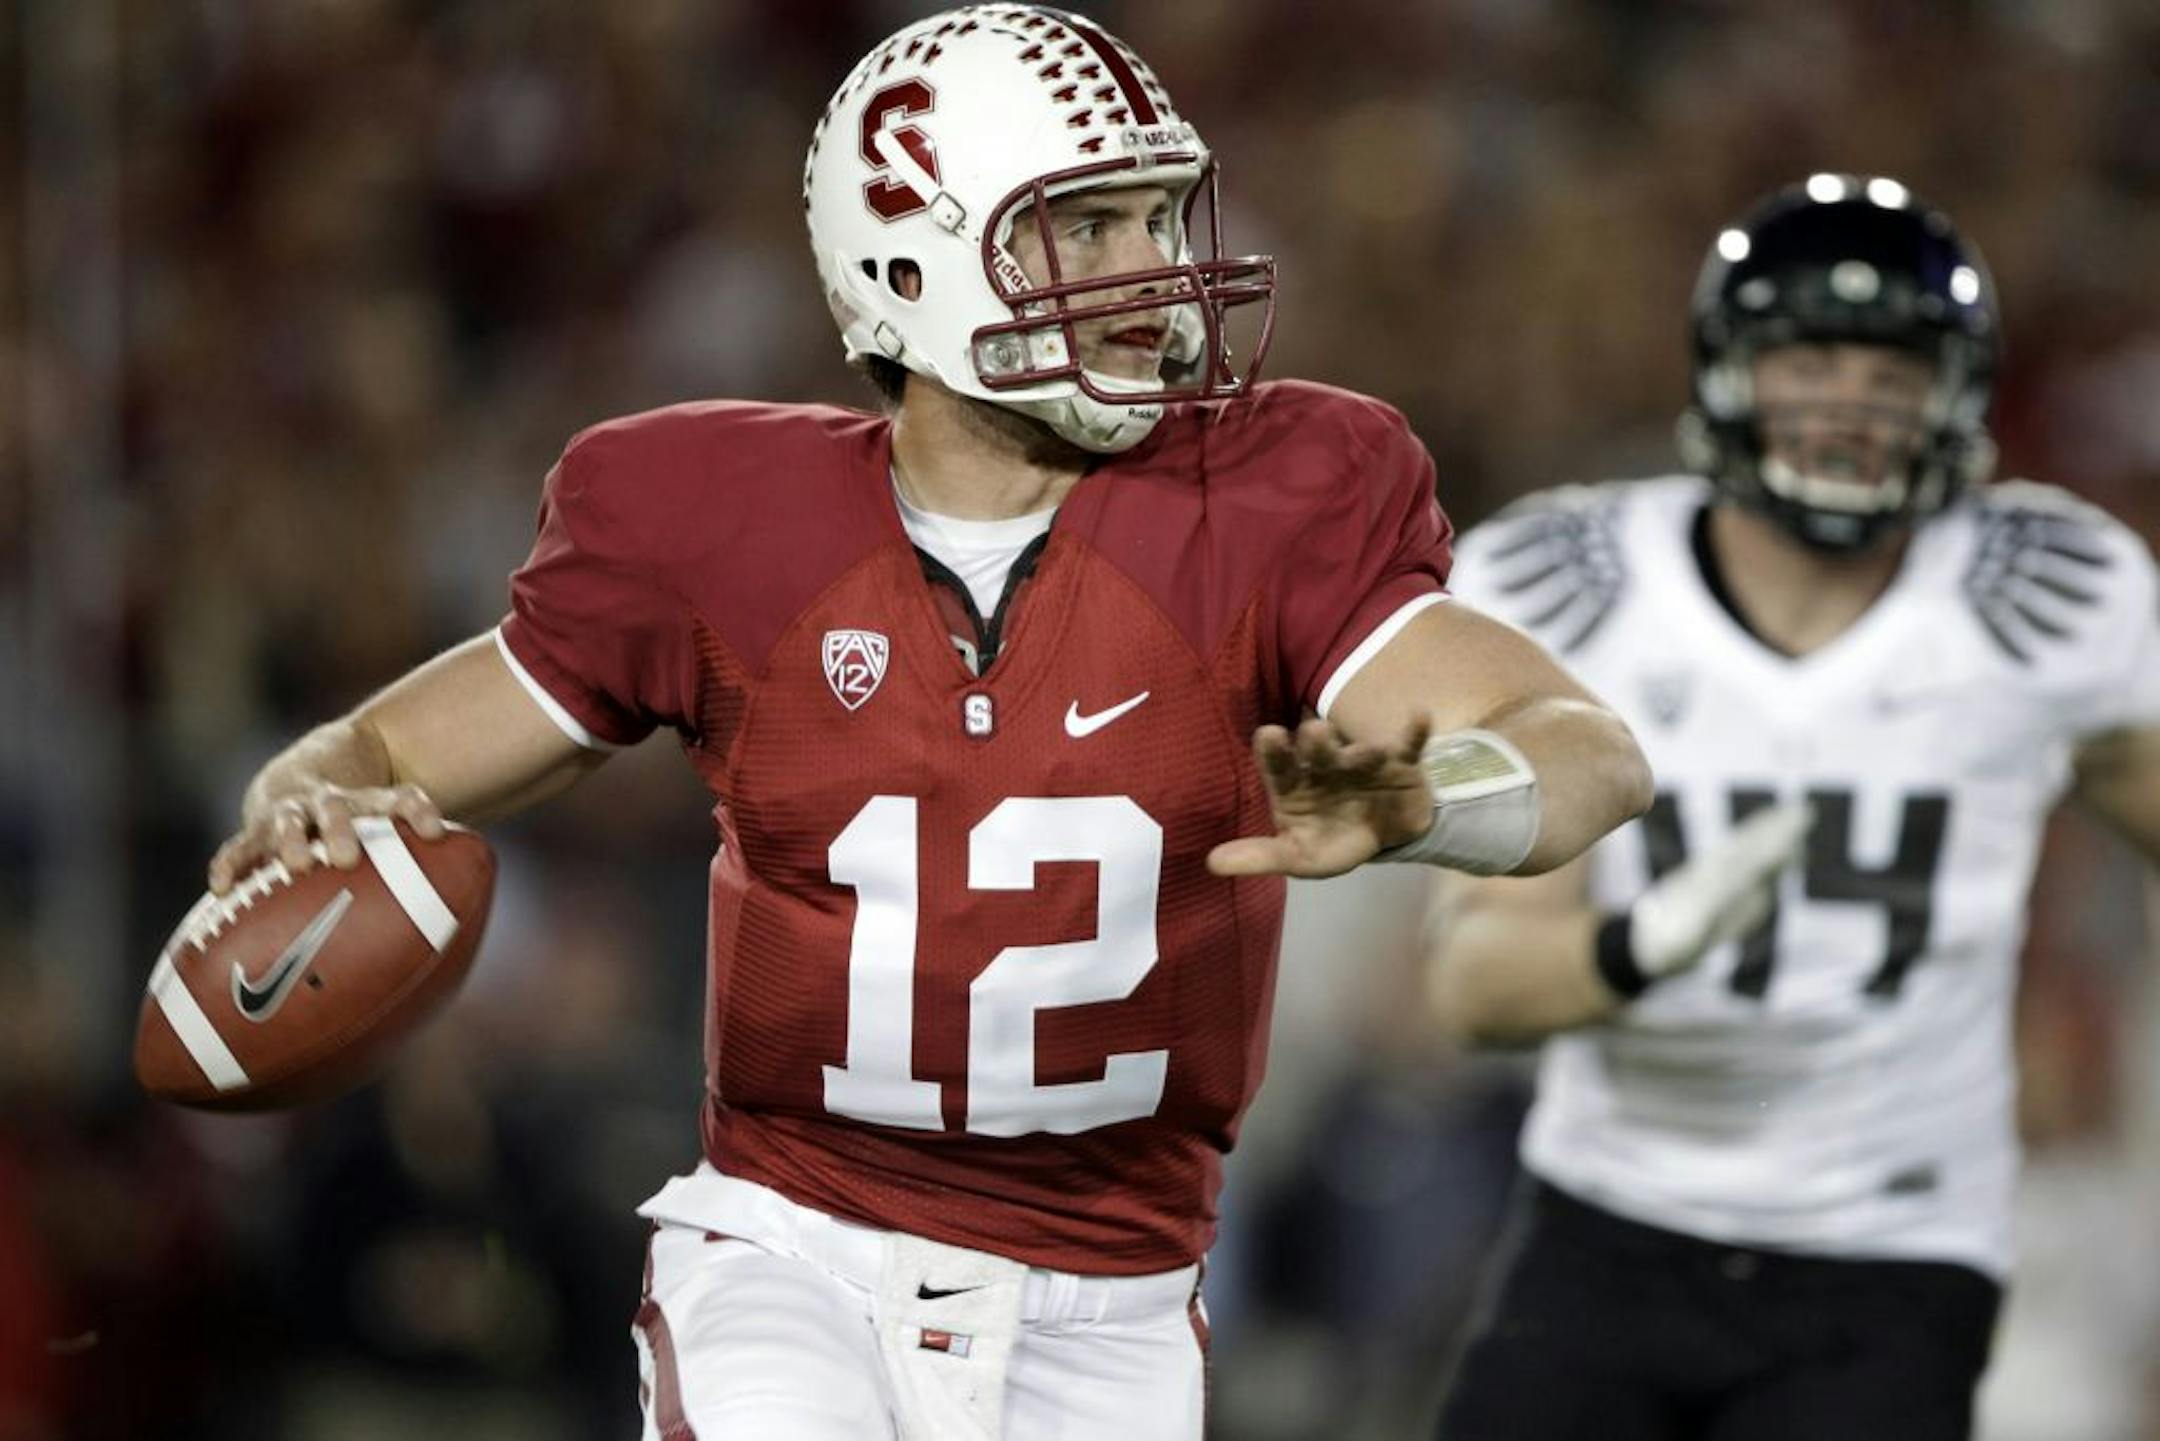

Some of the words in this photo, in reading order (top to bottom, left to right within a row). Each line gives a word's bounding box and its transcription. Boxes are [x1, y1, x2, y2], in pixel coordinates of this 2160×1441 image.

[859, 76, 942, 224] S
[827, 634, 885, 680] PAC
[838, 663, 869, 694] 12
[965, 694, 993, 735] S
[822, 795, 1169, 1138] 12
